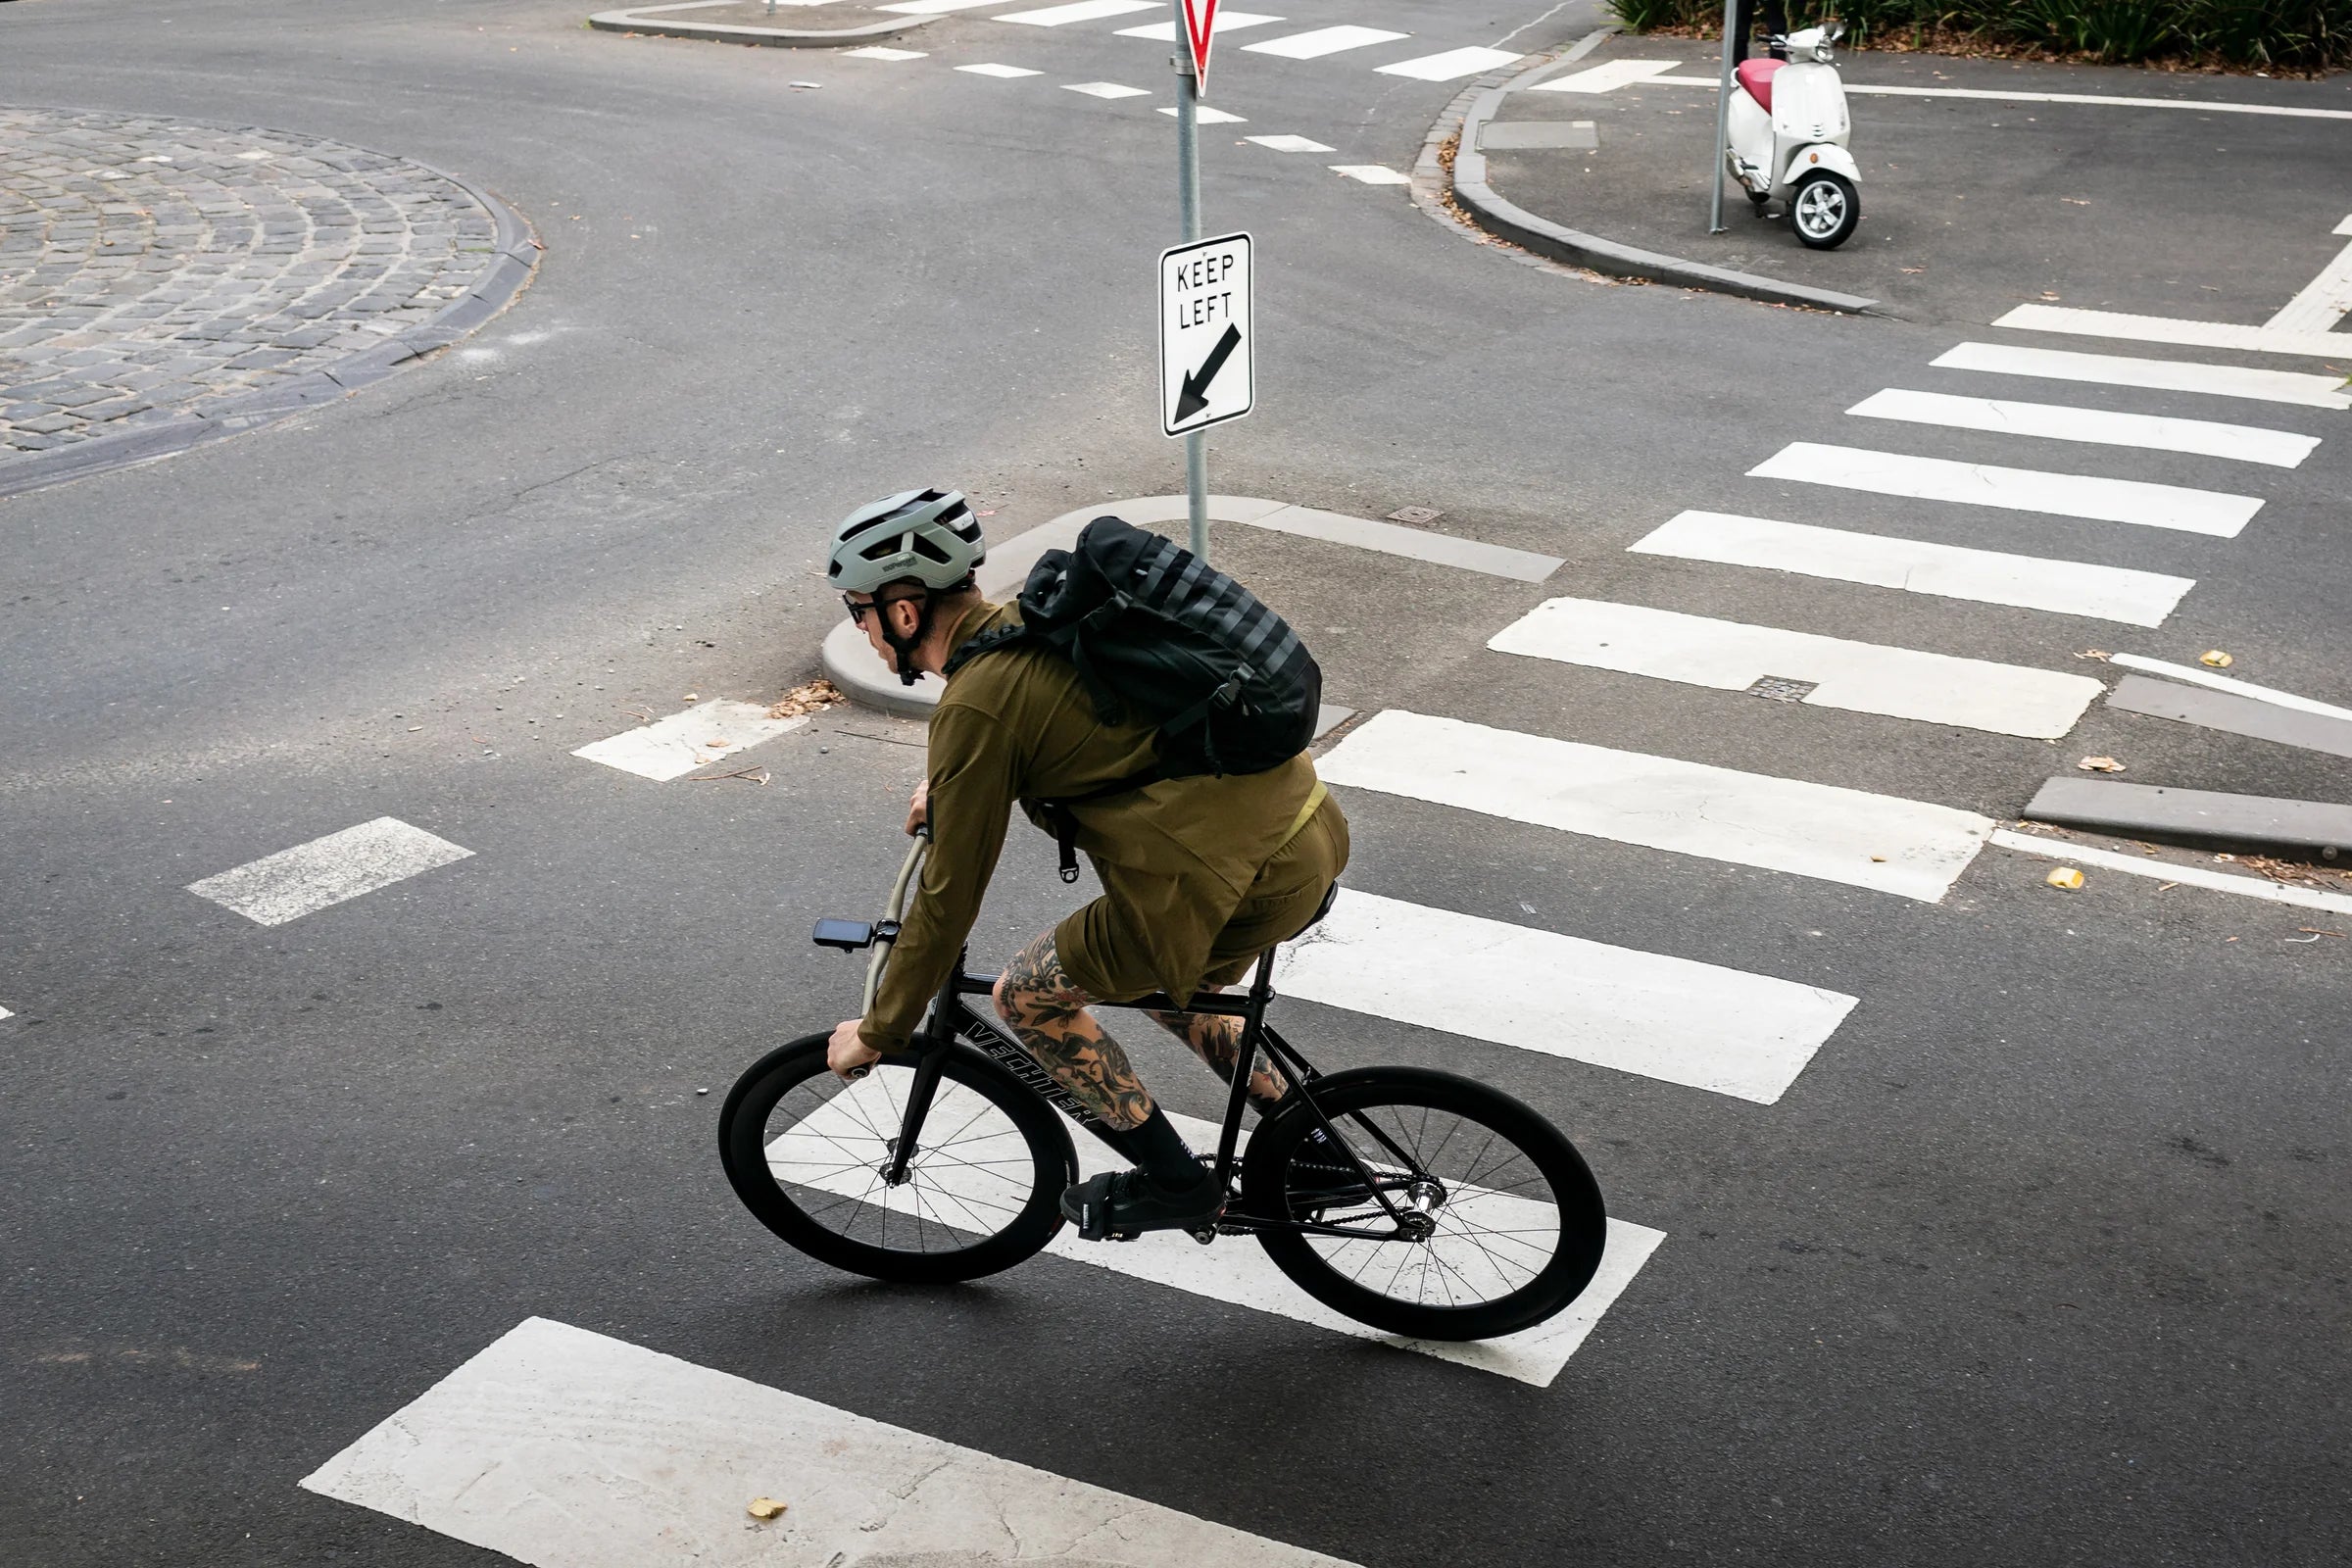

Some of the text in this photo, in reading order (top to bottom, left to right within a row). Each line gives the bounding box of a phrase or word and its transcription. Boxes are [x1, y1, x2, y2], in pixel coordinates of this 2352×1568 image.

[1177, 254, 1234, 292] KEEP
[1180, 292, 1232, 329] LEFT
[963, 1021, 1101, 1126] VECHTER
